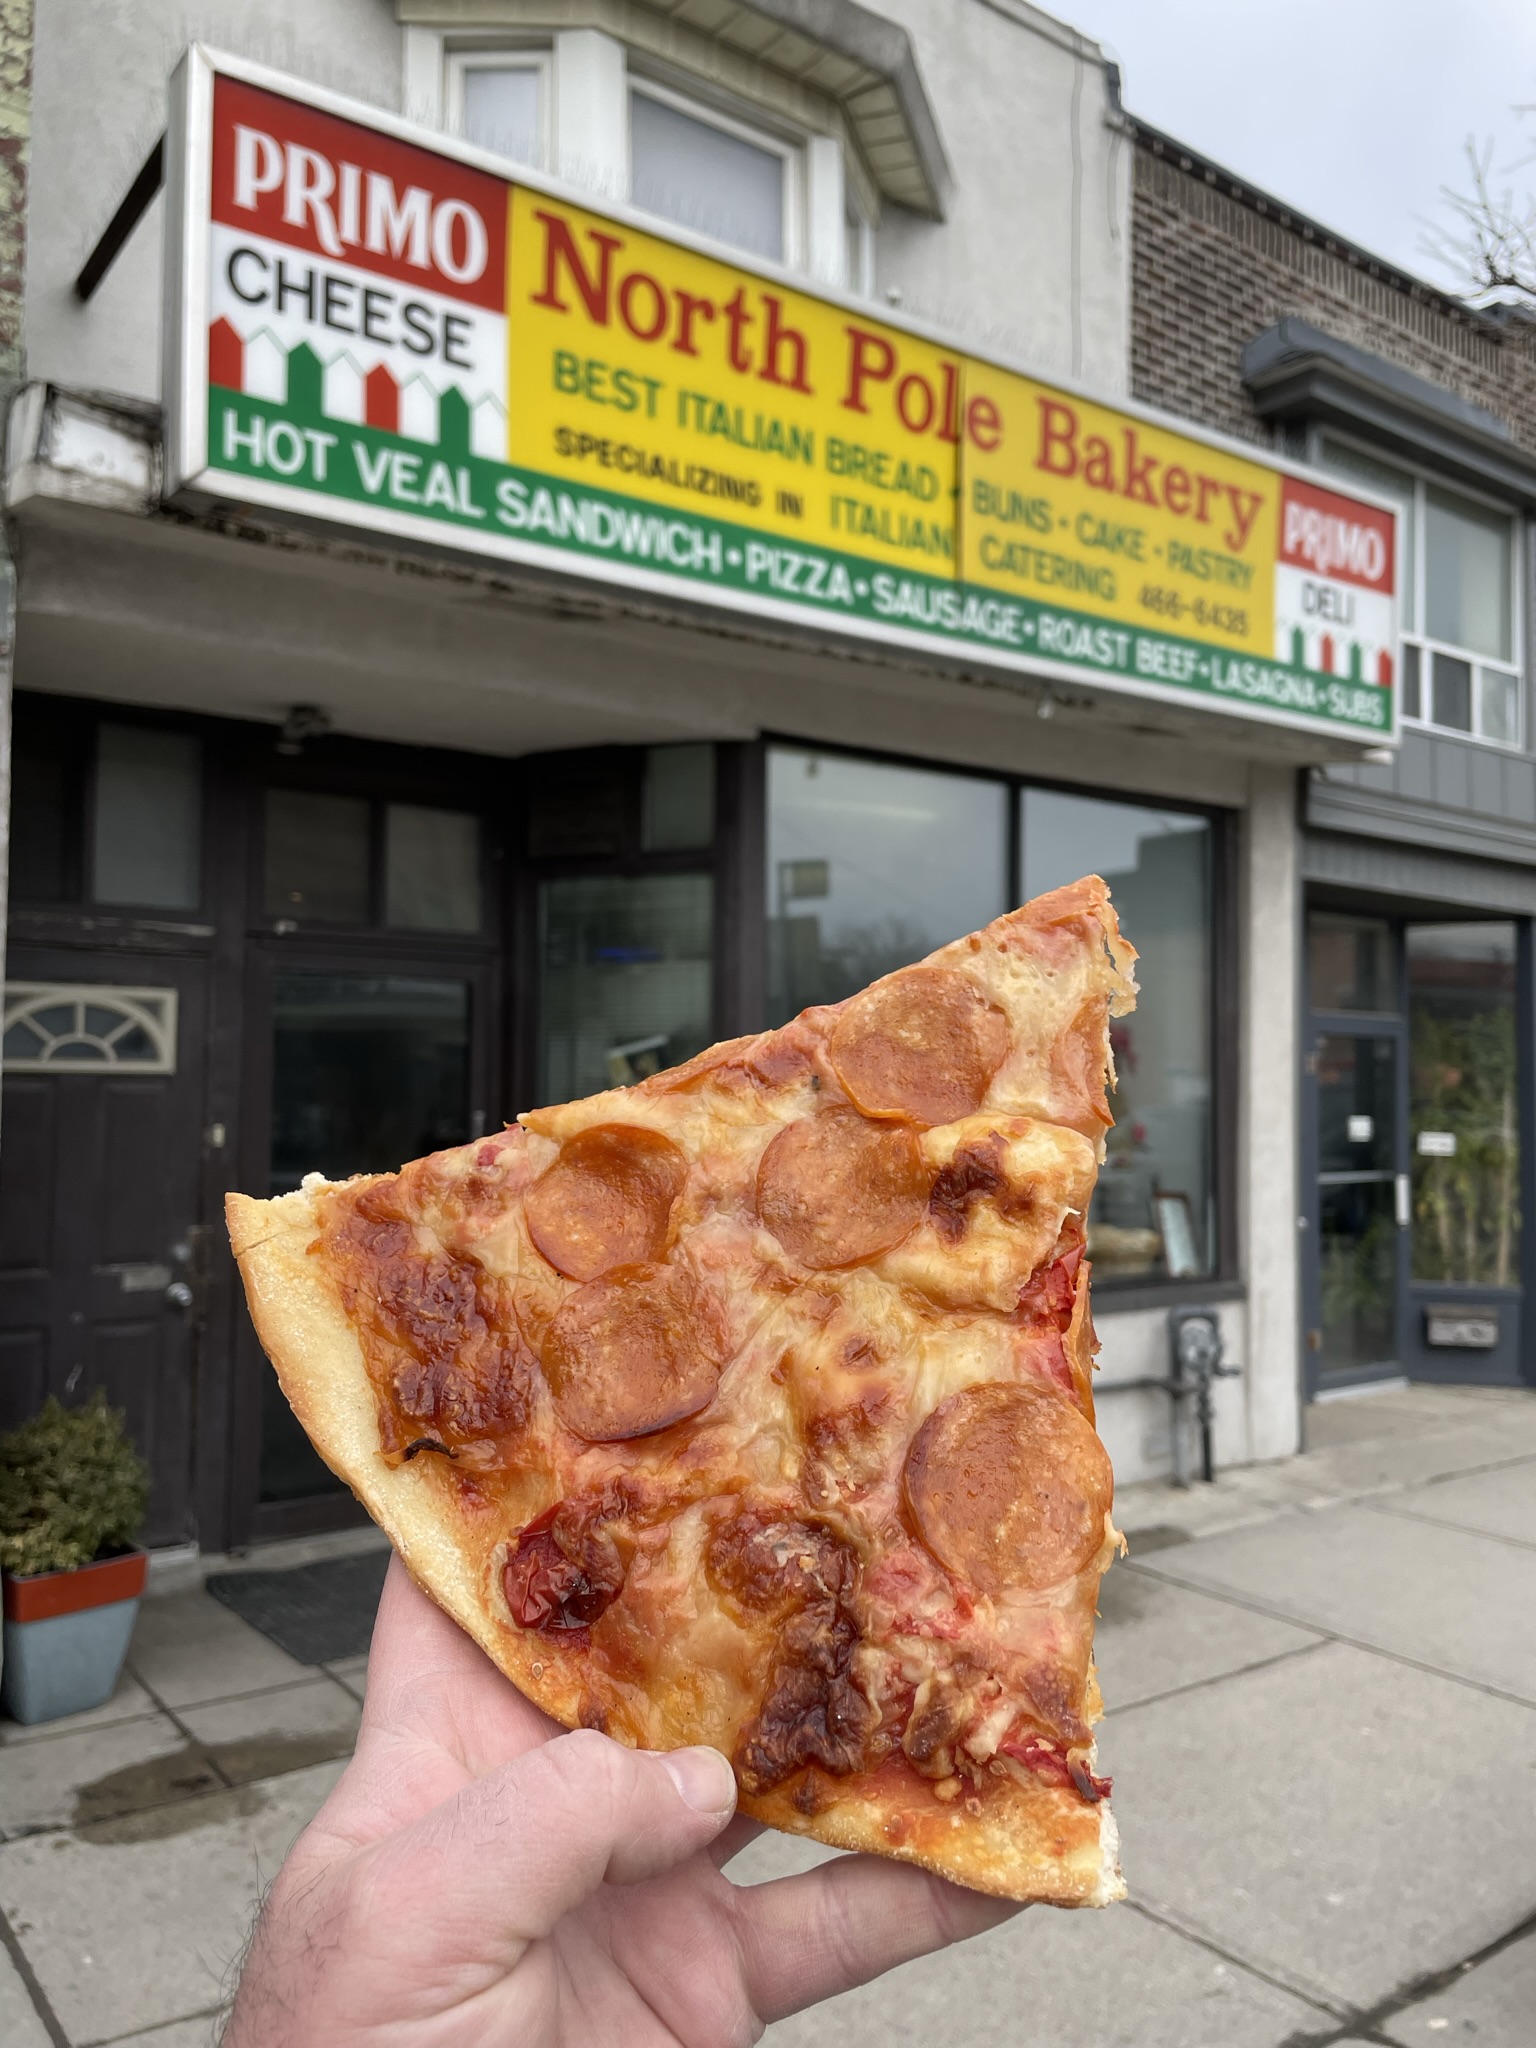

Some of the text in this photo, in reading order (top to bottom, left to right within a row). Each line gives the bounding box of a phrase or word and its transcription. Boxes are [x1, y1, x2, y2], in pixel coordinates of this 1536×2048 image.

[233, 123, 488, 284] PRIMO
[228, 248, 474, 370] CHEESE
[531, 210, 1264, 553] North Pole Bakery
[553, 427, 761, 507] SPECIALIZING
[775, 488, 804, 520] IN
[830, 495, 955, 561] ITALIAN
[979, 534, 1116, 603] CATERING
[554, 350, 1255, 593] BEST ITALIAN BREAD BUNS CAKE PASTRY
[1285, 501, 1386, 582] PRIMO
[223, 408, 1383, 726] HOT VEAL SANDWICH PIZZA SAUSAGE ROAST BEEF LASAGNA SUBS
[1303, 581, 1354, 626] DELI
